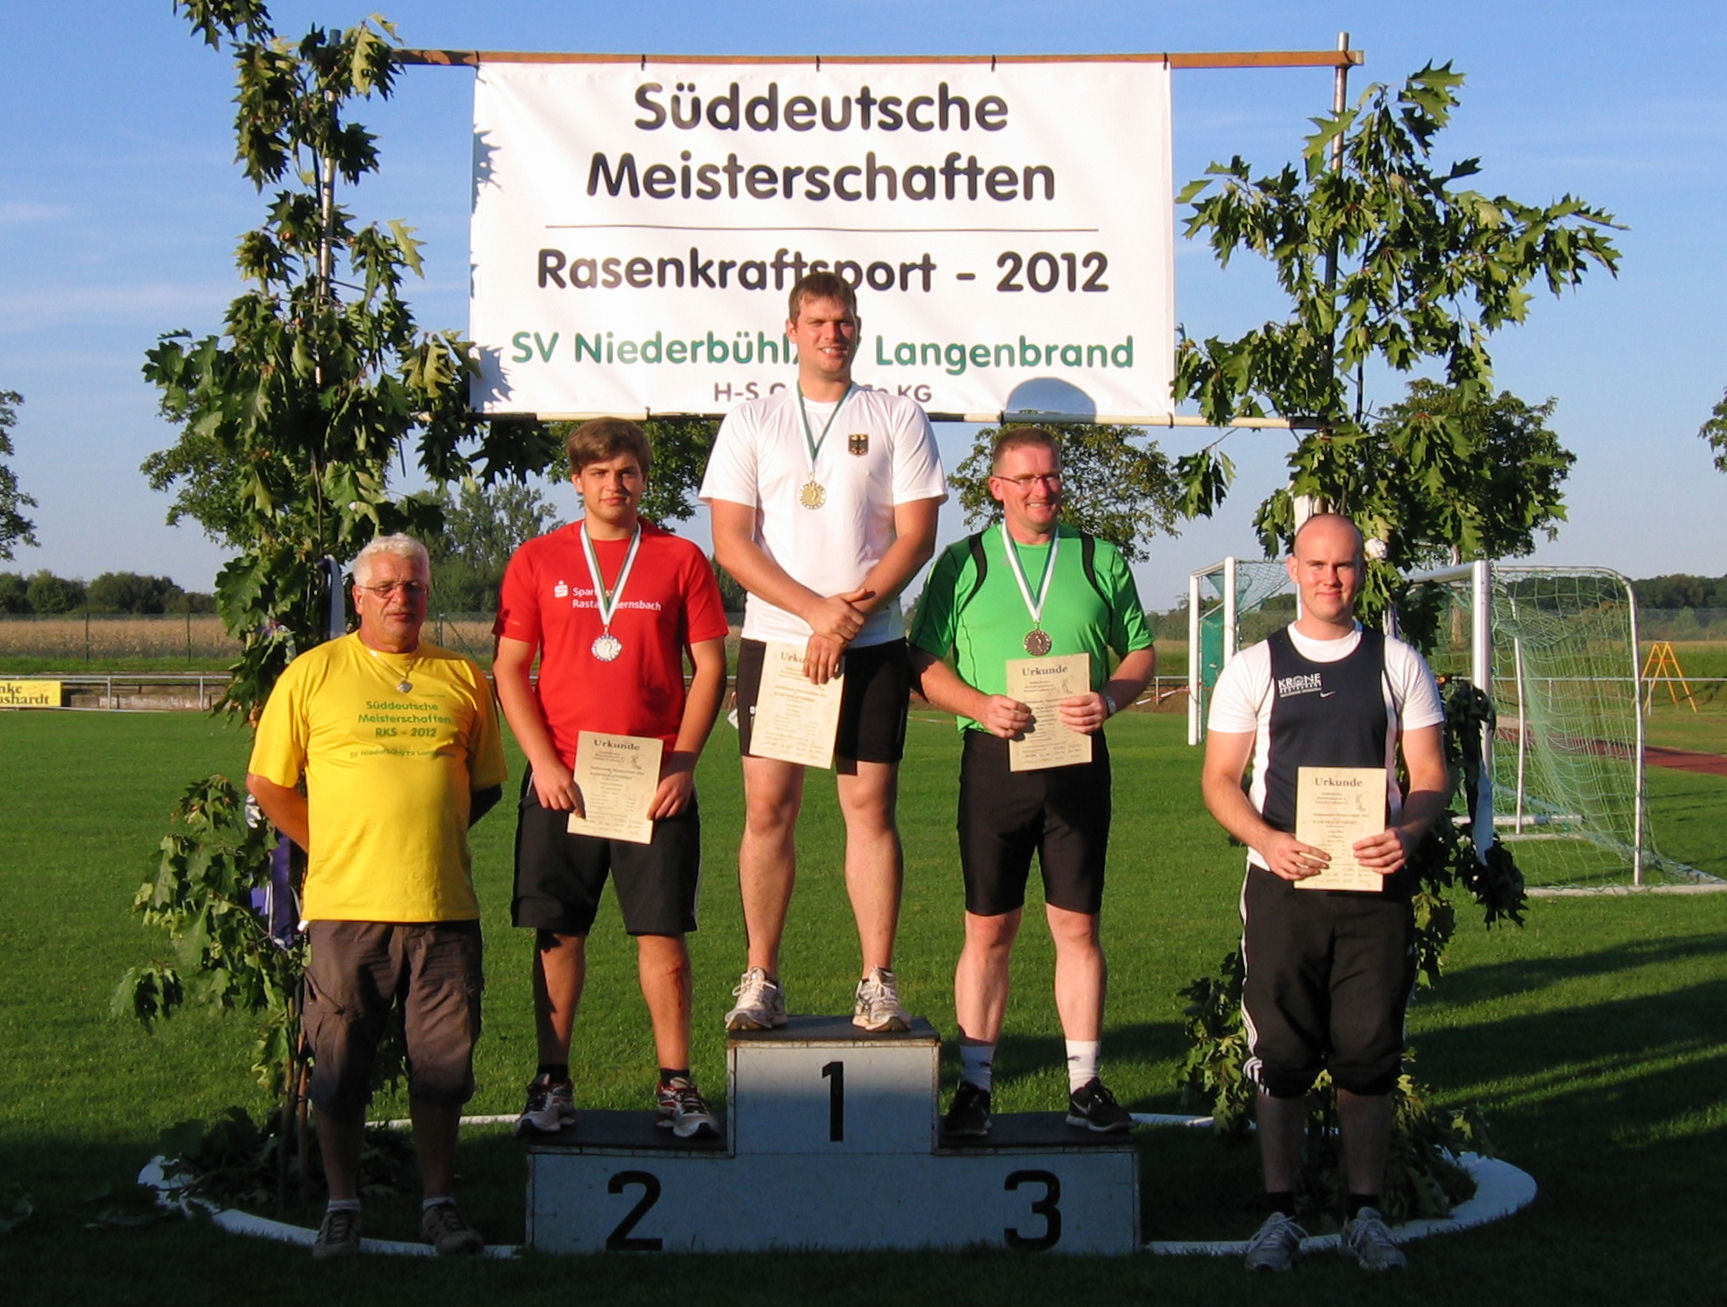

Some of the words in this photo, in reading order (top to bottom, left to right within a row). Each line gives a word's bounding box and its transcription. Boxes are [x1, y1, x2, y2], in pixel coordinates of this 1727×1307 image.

[634, 82, 1009, 132] Süddeutsche
[586, 150, 1056, 203] Meisterschaften
[956, 273, 976, 281] -
[996, 250, 1110, 295] 2012
[511, 331, 560, 363] SV
[574, 331, 799, 364] Niederbühl
[876, 332, 1134, 376] Langenbrand
[714, 381, 760, 402] H-S
[897, 383, 933, 403] KG
[1022, 664, 1069, 677] Urkunde
[1278, 673, 1321, 689] KRONE
[366, 700, 439, 711] Süddeutsche
[358, 714, 452, 724] Meisterschaften
[375, 727, 397, 737] RKS
[411, 727, 437, 737] 2012
[593, 738, 640, 751] Urkunde
[1314, 777, 1363, 787] Urkunde
[821, 1060, 845, 1142] 1
[605, 1170, 663, 1251] 2
[1003, 1169, 1062, 1252] 3
